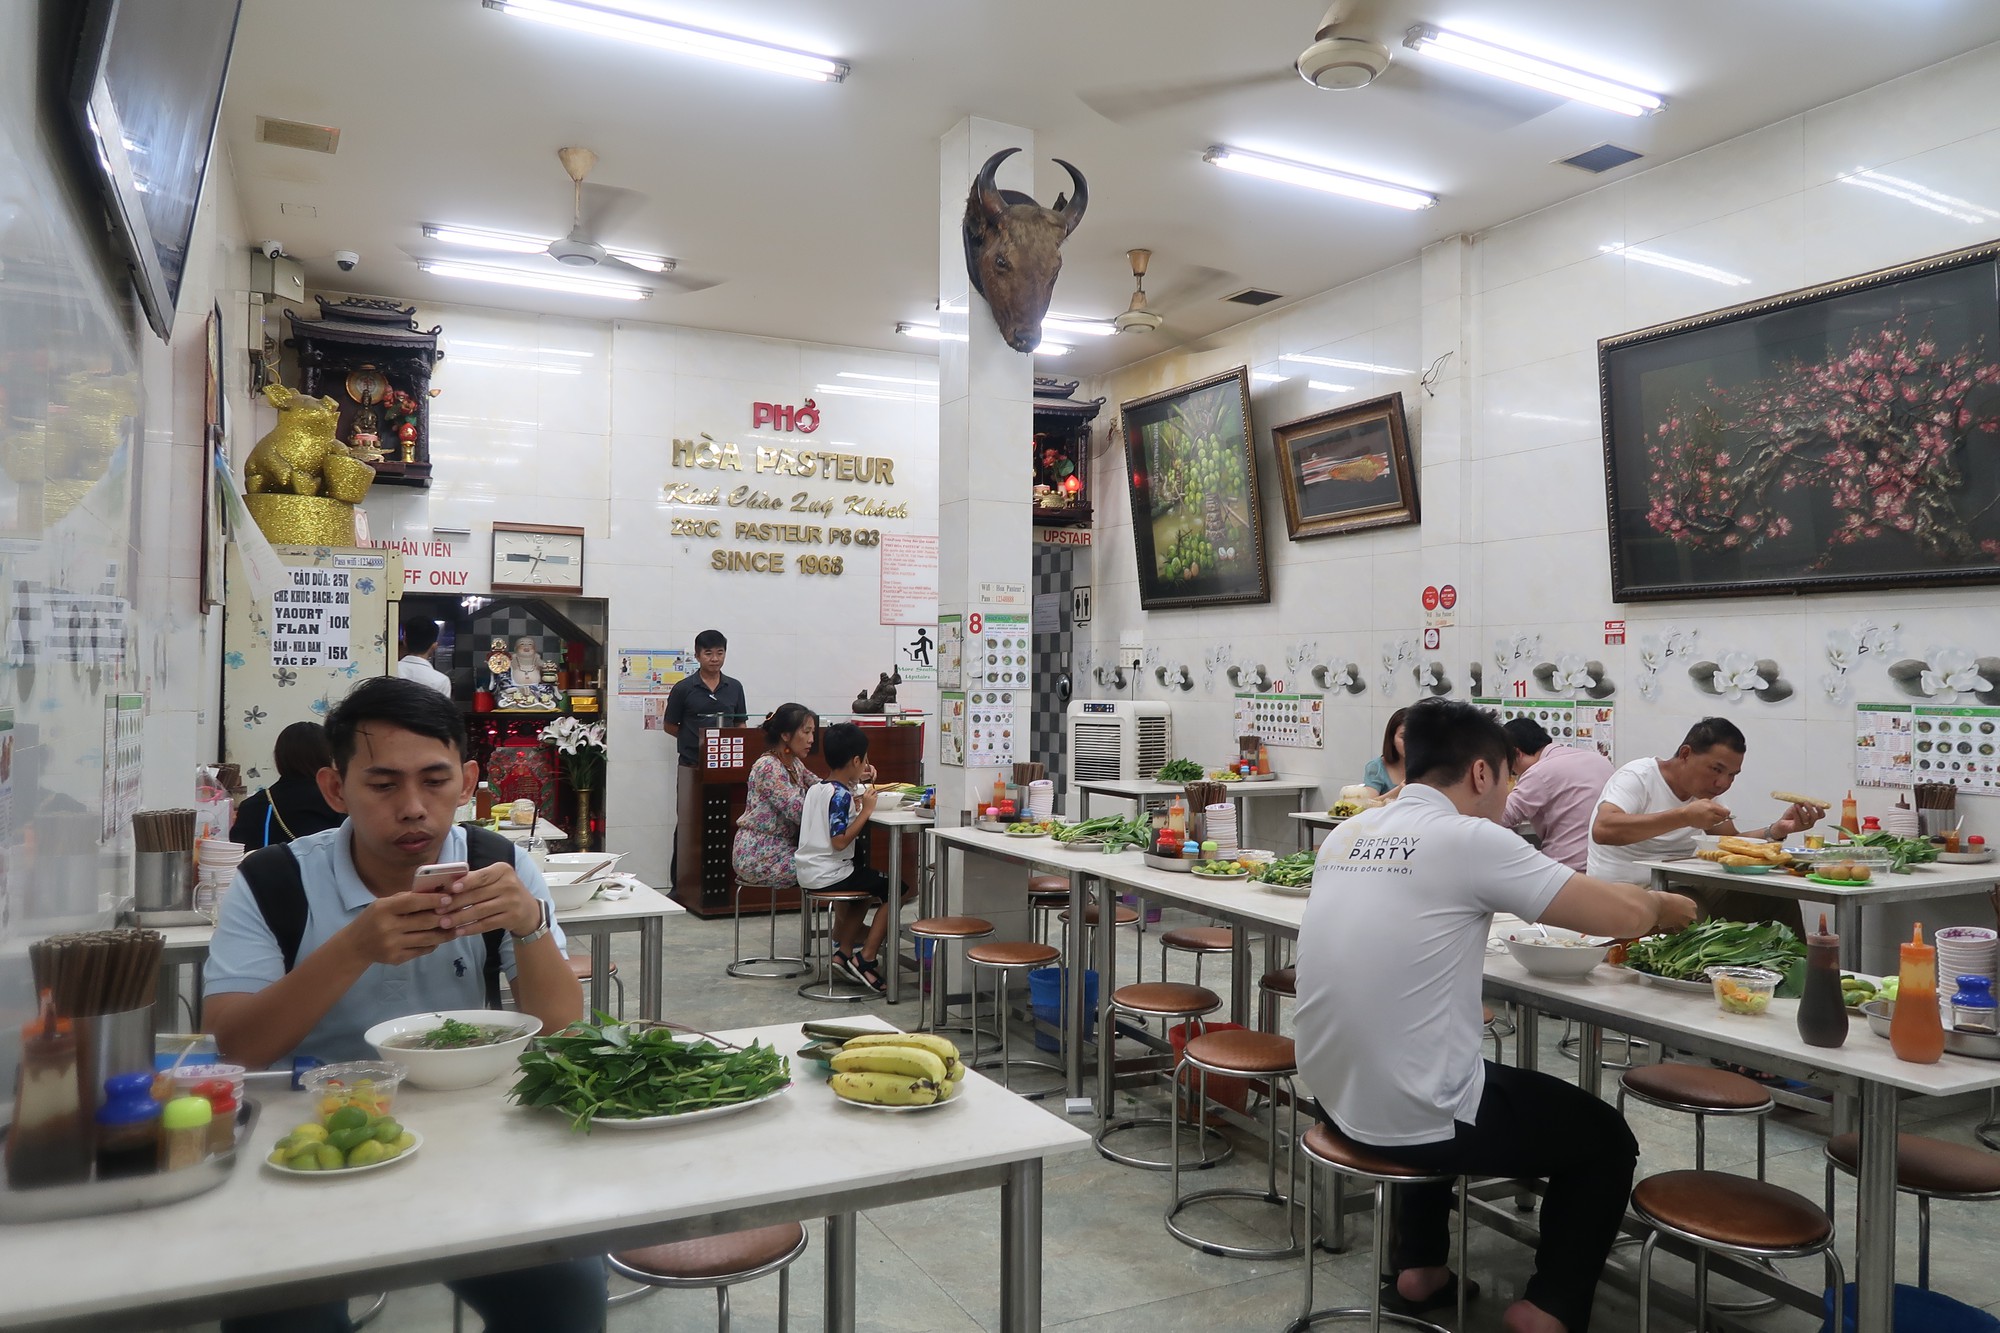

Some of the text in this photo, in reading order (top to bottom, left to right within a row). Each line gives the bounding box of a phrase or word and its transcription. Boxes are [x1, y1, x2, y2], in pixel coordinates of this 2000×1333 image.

[753, 397, 821, 433] PHỞ
[671, 431, 895, 485] HÒA PASTEUR
[728, 485, 783, 510] Chào
[843, 495, 909, 519] Khách
[735, 521, 822, 544] PASTEUR
[422, 538, 451, 557] VIÊN
[711, 549, 785, 574] SINCE
[333, 573, 349, 587] 25K
[429, 570, 469, 586] ONLY
[335, 591, 350, 605] 20K
[275, 608, 323, 620] YAOURT
[276, 623, 319, 635] FLAN
[330, 616, 350, 629] 10K
[969, 612, 982, 634] 8
[328, 646, 348, 660] 15K
[1272, 680, 1284, 693] 10
[1512, 680, 1527, 697] 11
[1355, 837, 1420, 848] BIRTHDAY
[1349, 847, 1416, 860] PARTY
